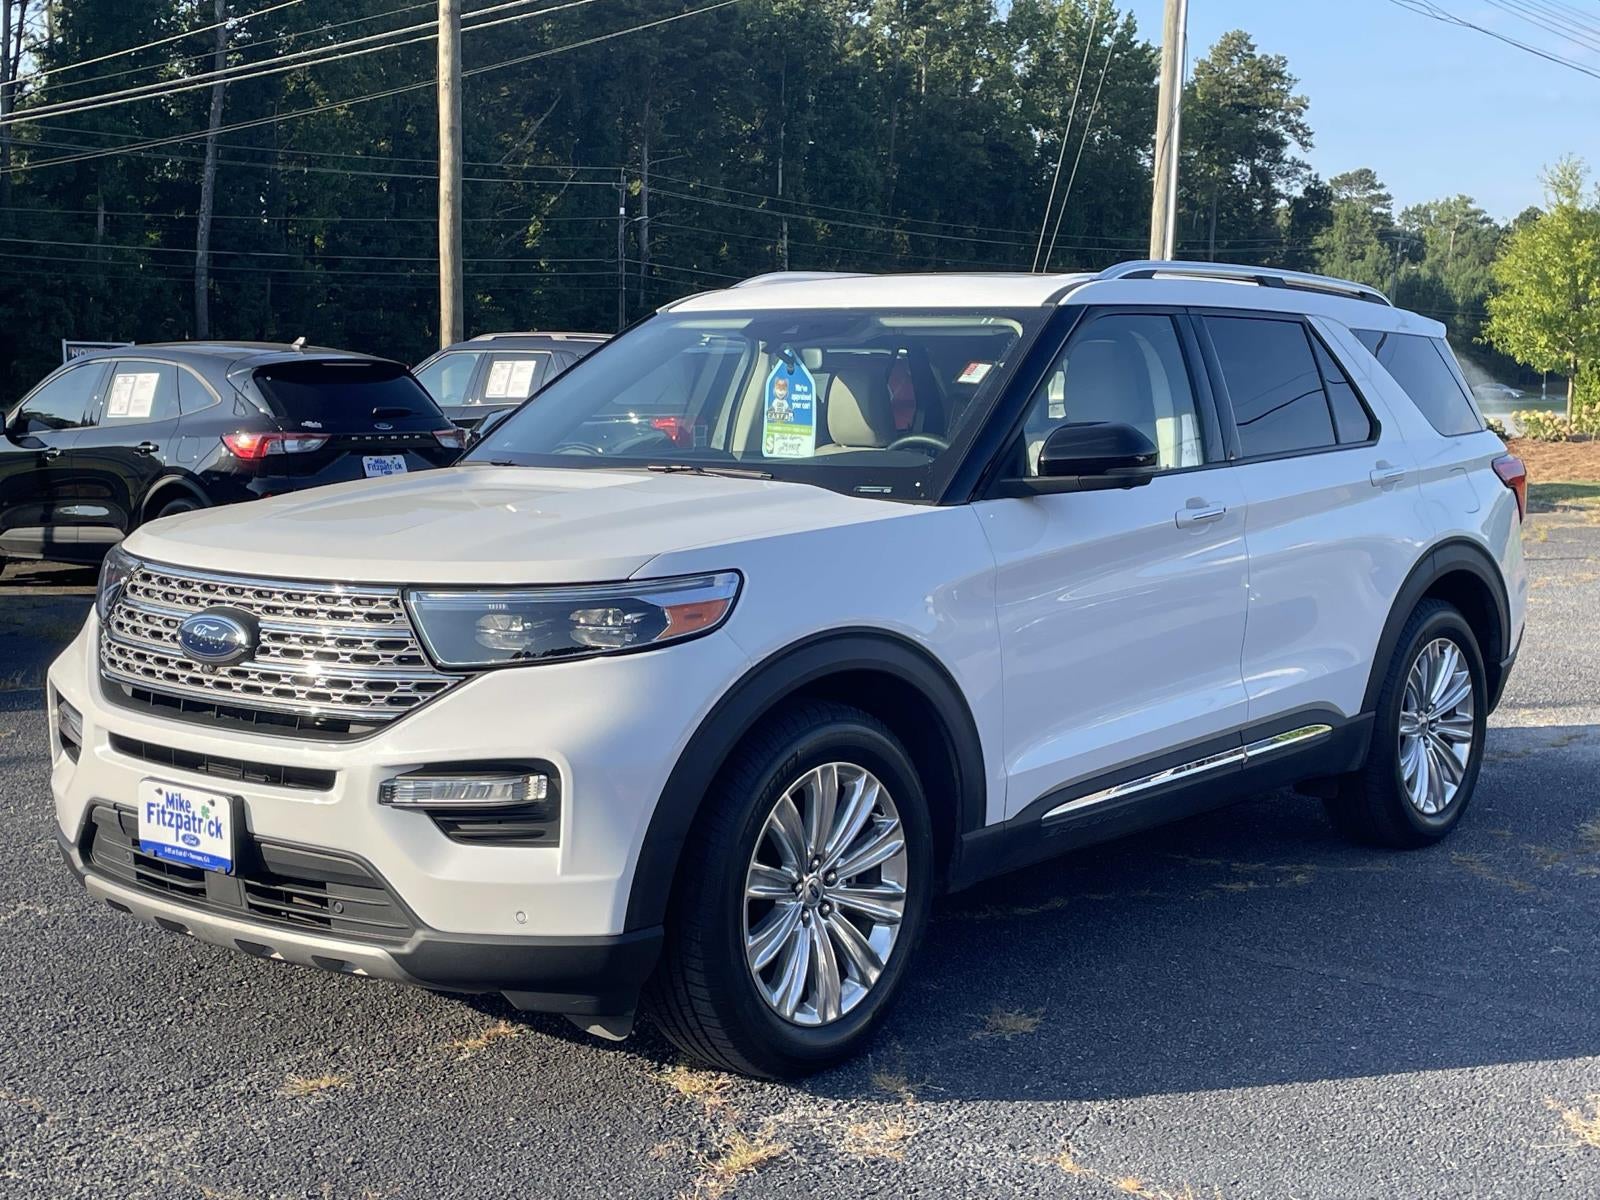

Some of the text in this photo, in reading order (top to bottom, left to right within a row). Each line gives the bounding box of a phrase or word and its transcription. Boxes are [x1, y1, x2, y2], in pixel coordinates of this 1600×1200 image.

[792, 401, 801, 410] your
[367, 462, 403, 474] Fitzpatrick
[193, 623, 228, 645] Ford
[165, 791, 191, 814] Mike
[146, 802, 223, 842] Fitzpatrick
[182, 834, 199, 846] Ford
